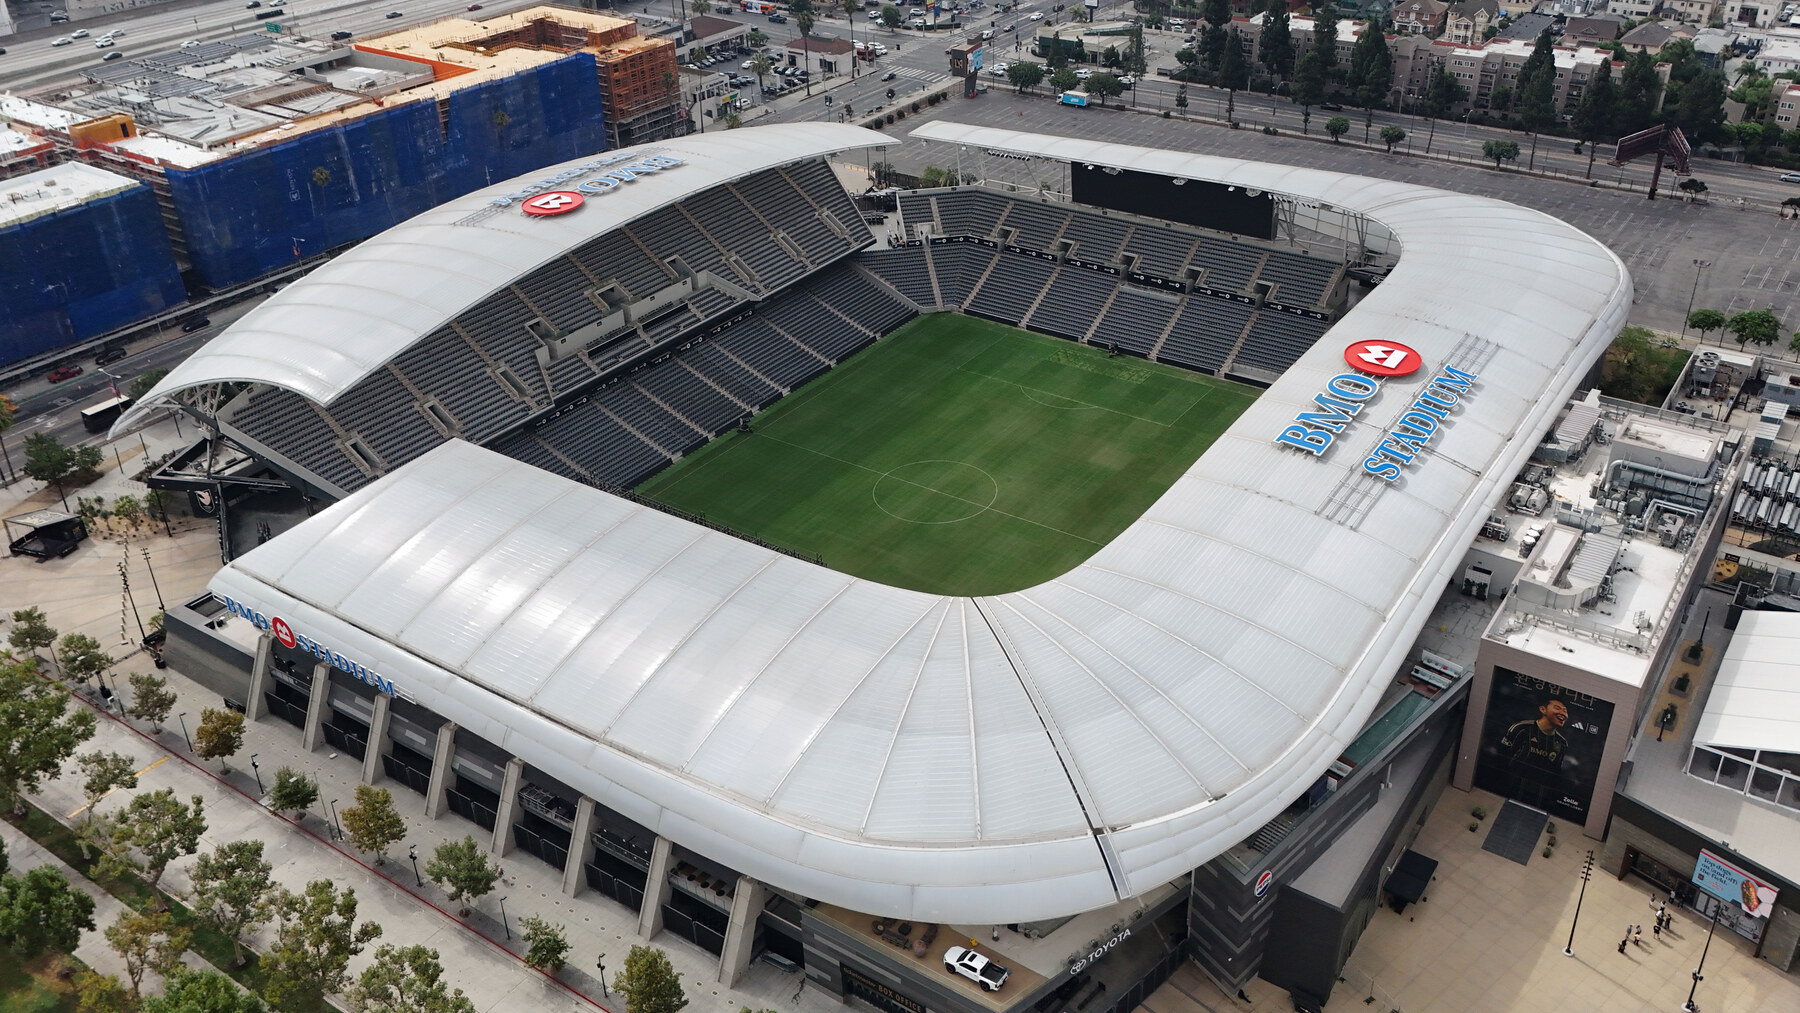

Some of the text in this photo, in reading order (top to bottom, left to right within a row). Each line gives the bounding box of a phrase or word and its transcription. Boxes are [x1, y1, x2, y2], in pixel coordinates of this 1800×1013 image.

[577, 155, 684, 193] BMO
[1274, 373, 1379, 457] BMO
[1363, 364, 1479, 482] STADIUM
[224, 594, 396, 698] BMO STADIUM
[1699, 867, 1711, 876] the
[1703, 857, 1732, 876] Top dogs
[1088, 928, 1131, 962] TOYOTA
[878, 984, 894, 998] BOX
[895, 994, 921, 1012] OFFICE
